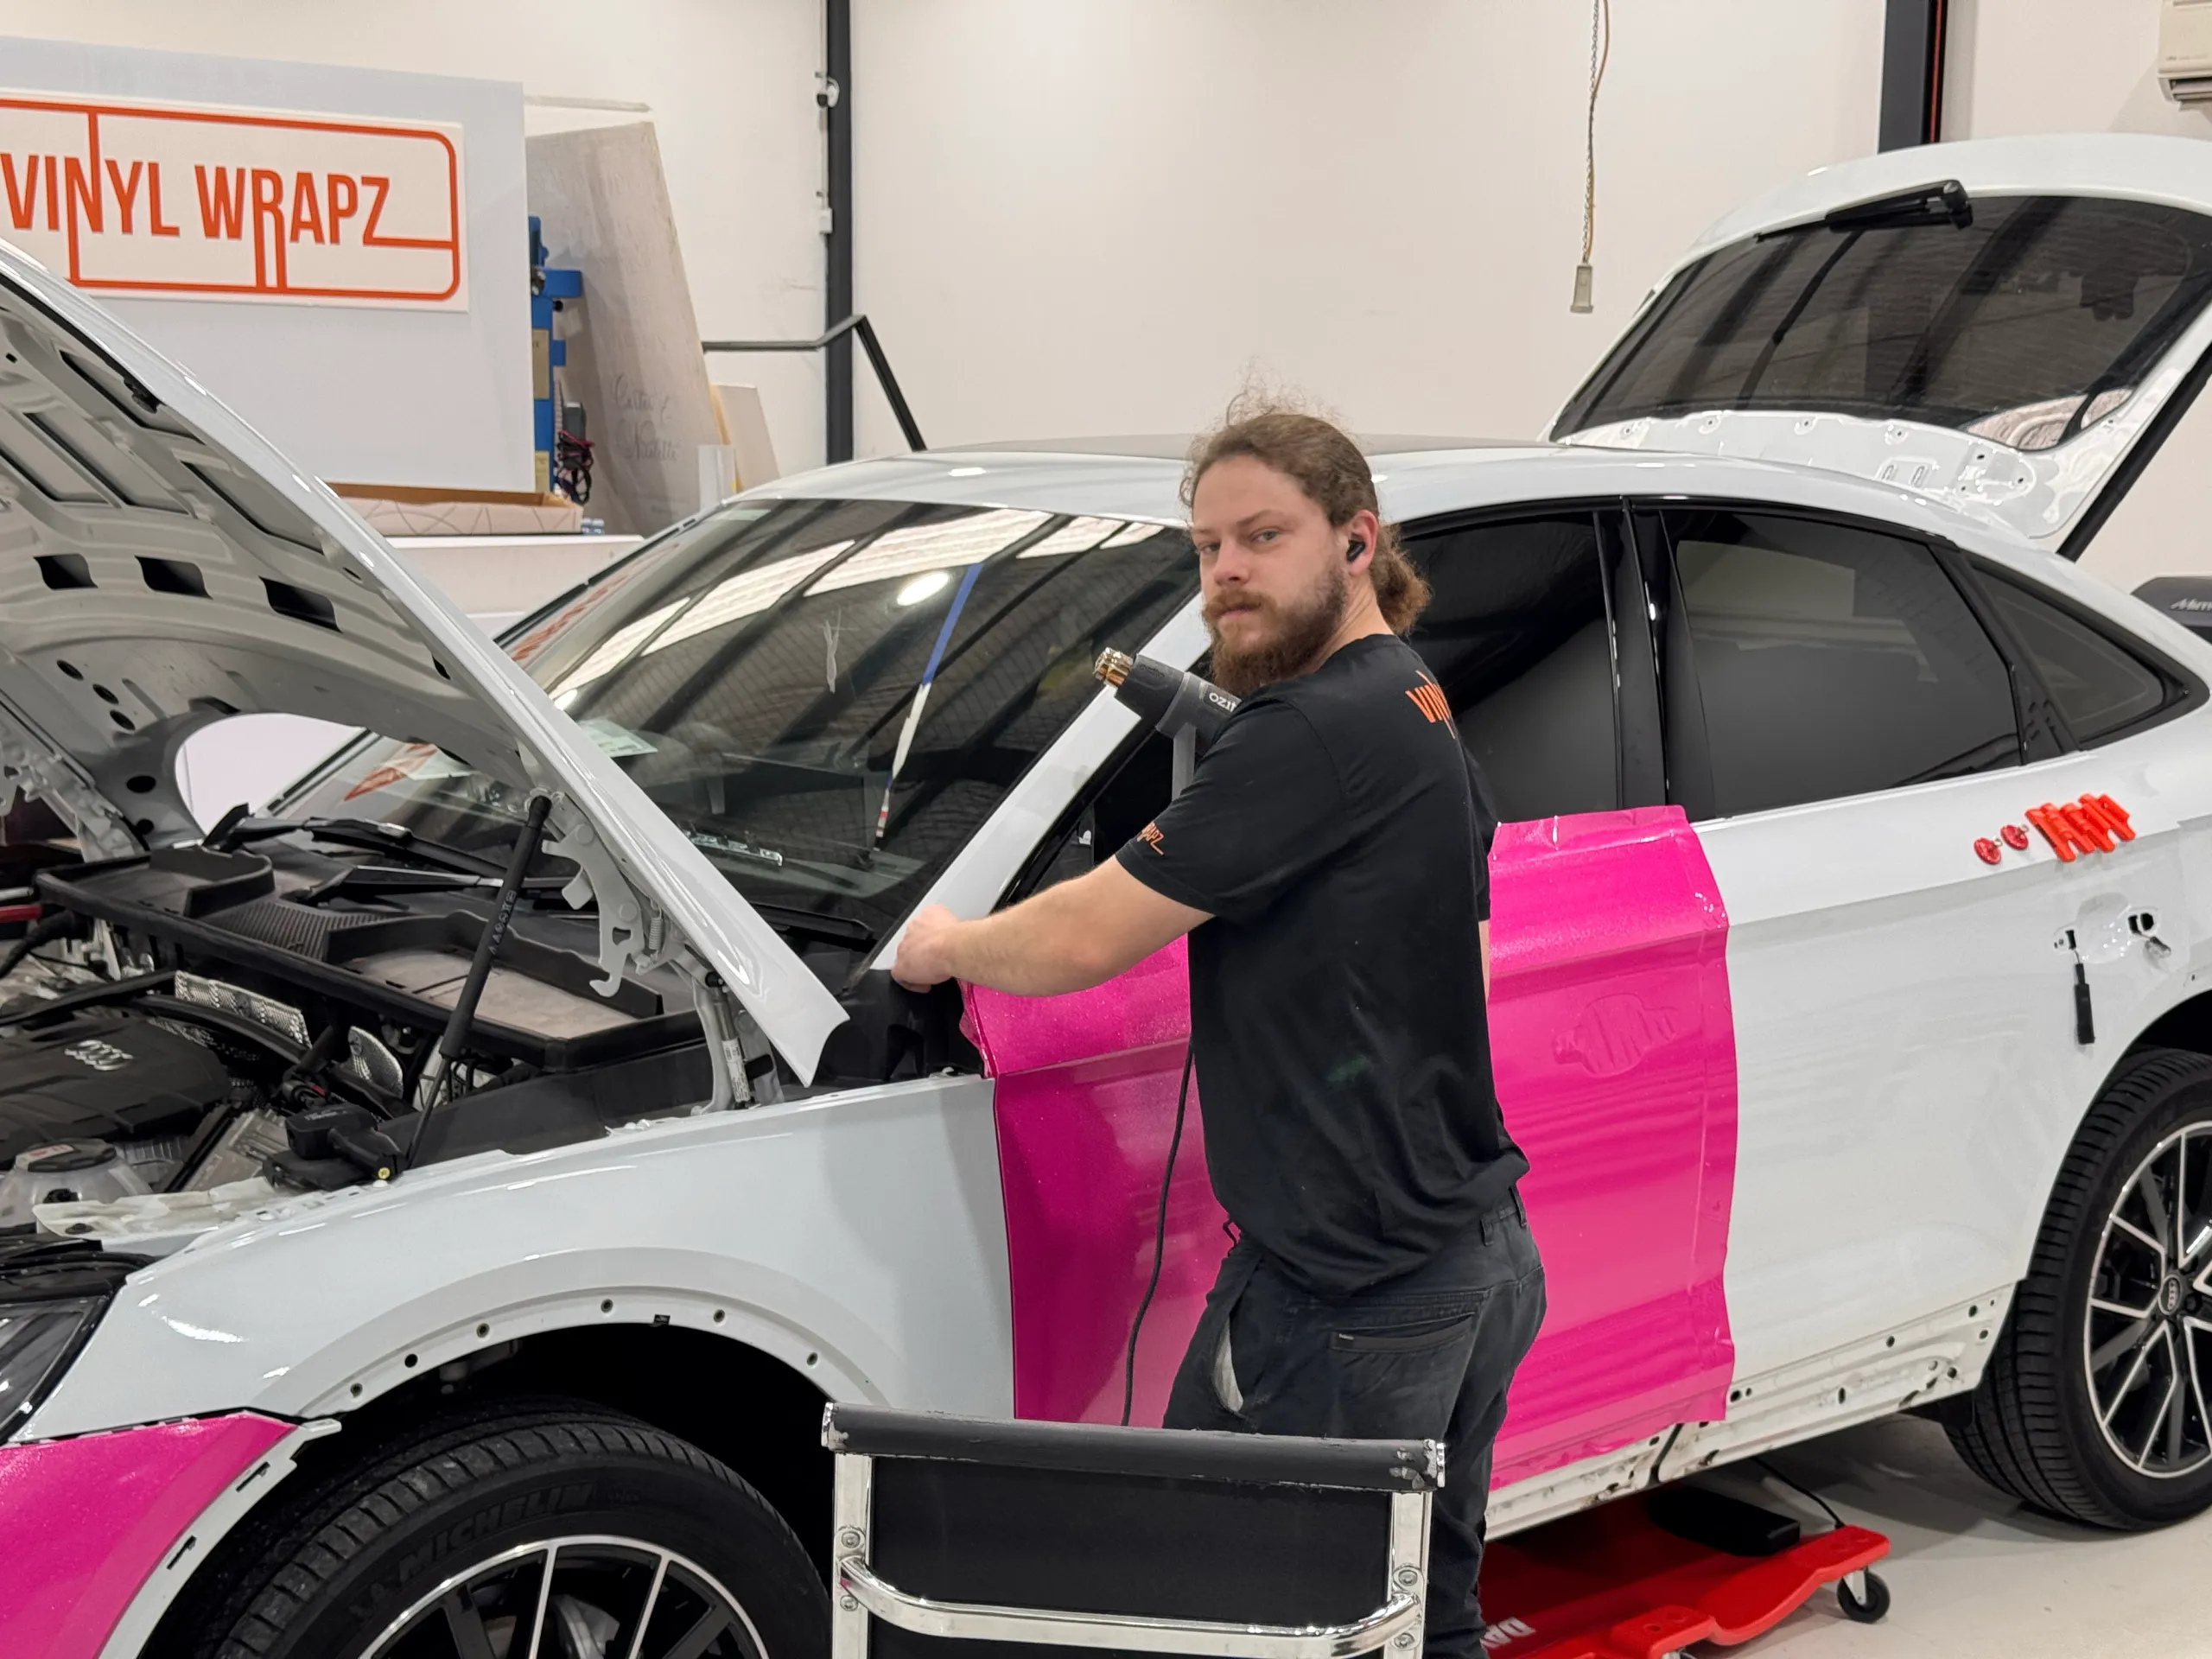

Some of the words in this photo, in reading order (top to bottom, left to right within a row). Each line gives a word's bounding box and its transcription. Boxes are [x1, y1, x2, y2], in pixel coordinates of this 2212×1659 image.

[0, 121, 180, 278] VINYL
[194, 164, 408, 283] WRAPZ
[397, 1482, 597, 1582] MICHELIN
